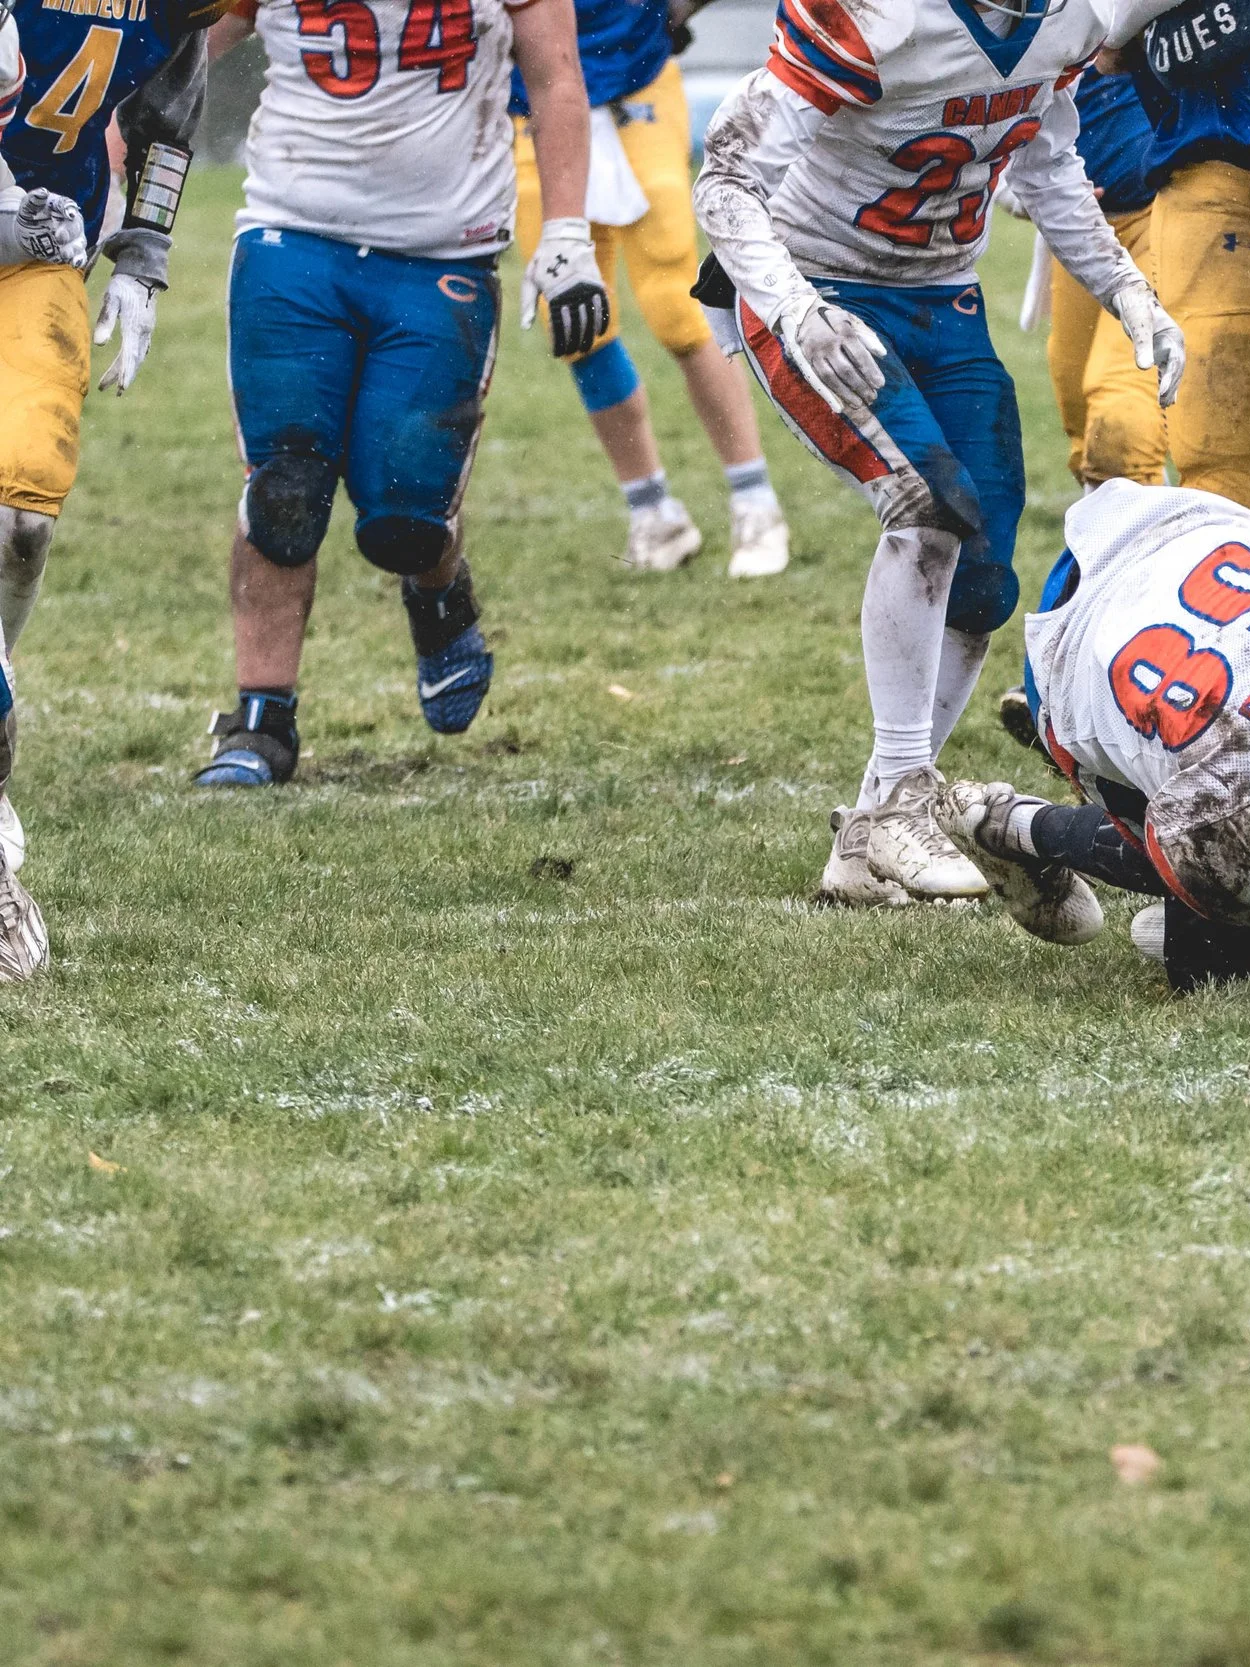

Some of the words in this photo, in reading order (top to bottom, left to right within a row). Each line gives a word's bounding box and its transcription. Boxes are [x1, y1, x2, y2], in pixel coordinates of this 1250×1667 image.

[25, 25, 123, 154] 4
[292, 0, 478, 100] 54
[943, 82, 1044, 127] CANBY
